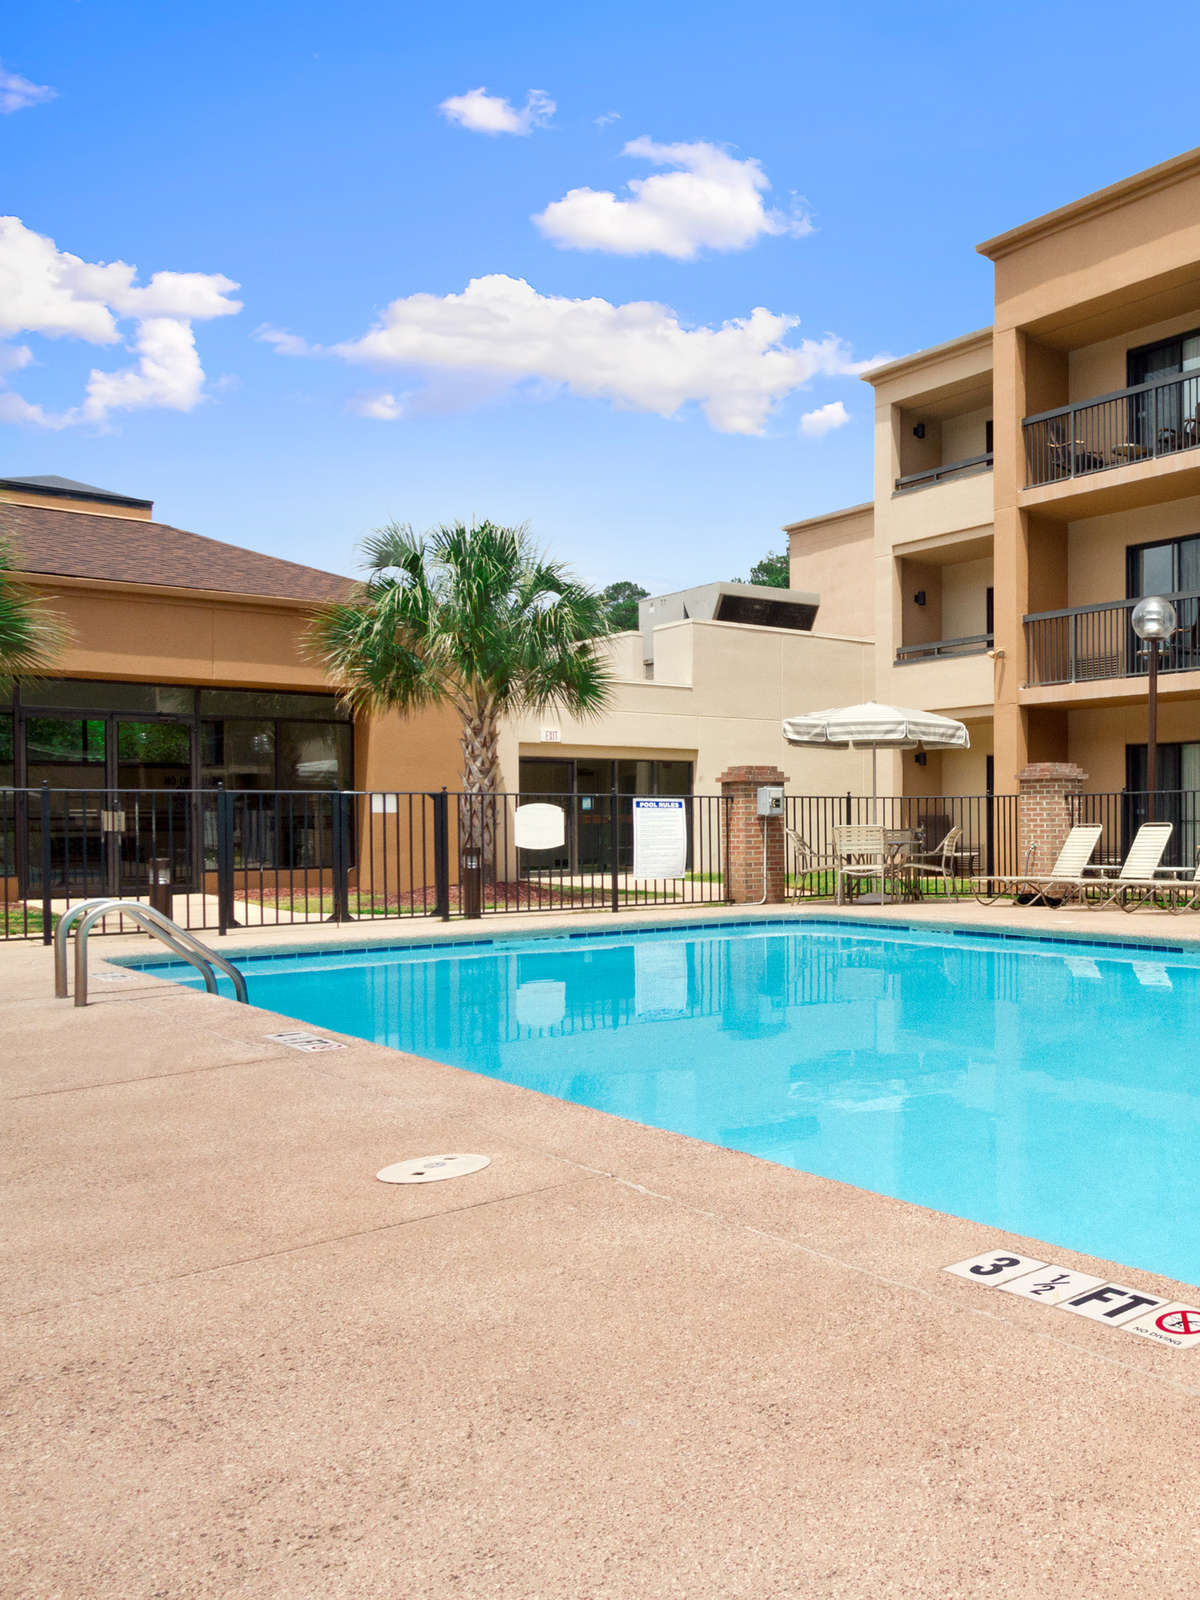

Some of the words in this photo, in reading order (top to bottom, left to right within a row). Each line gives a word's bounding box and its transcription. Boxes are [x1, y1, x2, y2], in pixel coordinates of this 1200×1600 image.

[970, 1257, 1020, 1275] 3
[1068, 1286, 1160, 1318] FT
[1149, 1332, 1182, 1346] DIVING
